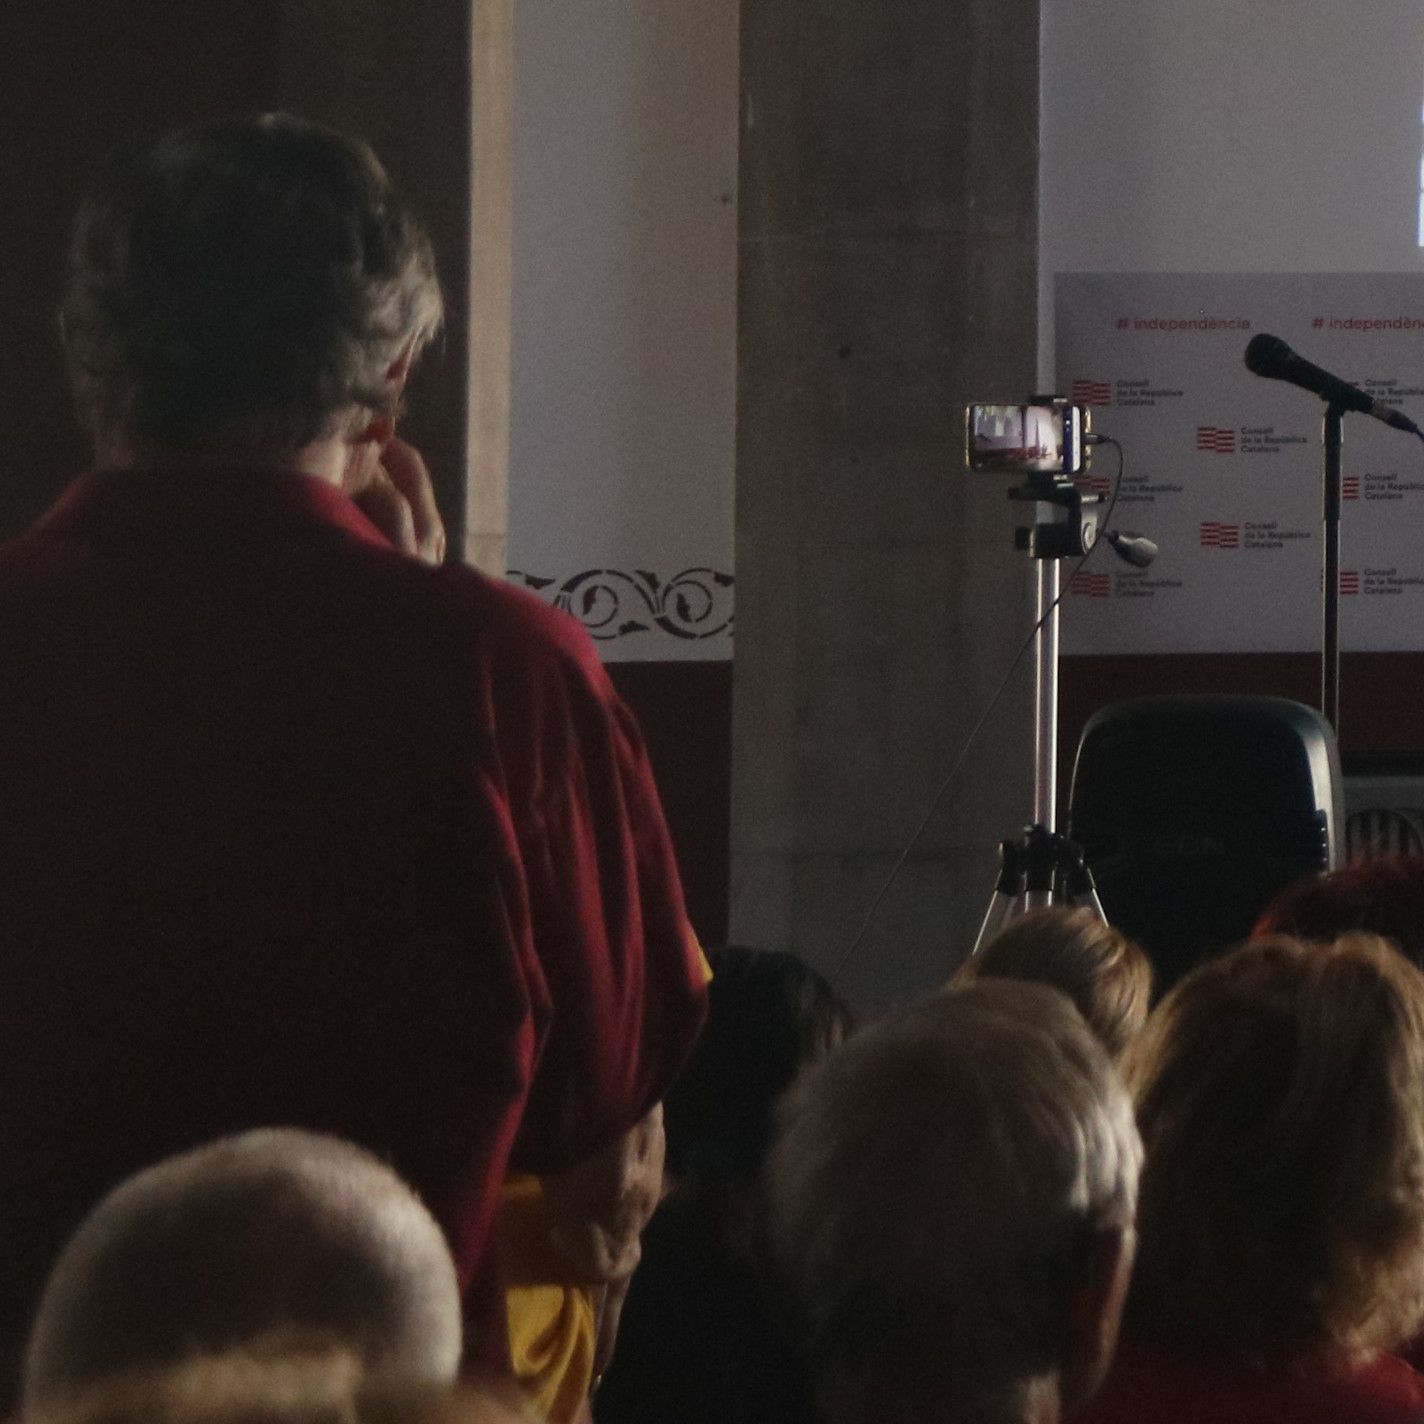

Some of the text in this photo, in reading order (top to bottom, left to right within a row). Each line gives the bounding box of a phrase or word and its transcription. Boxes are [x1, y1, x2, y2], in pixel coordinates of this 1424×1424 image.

[1118, 316, 1250, 332] # independència
[1313, 317, 1324, 329] #
